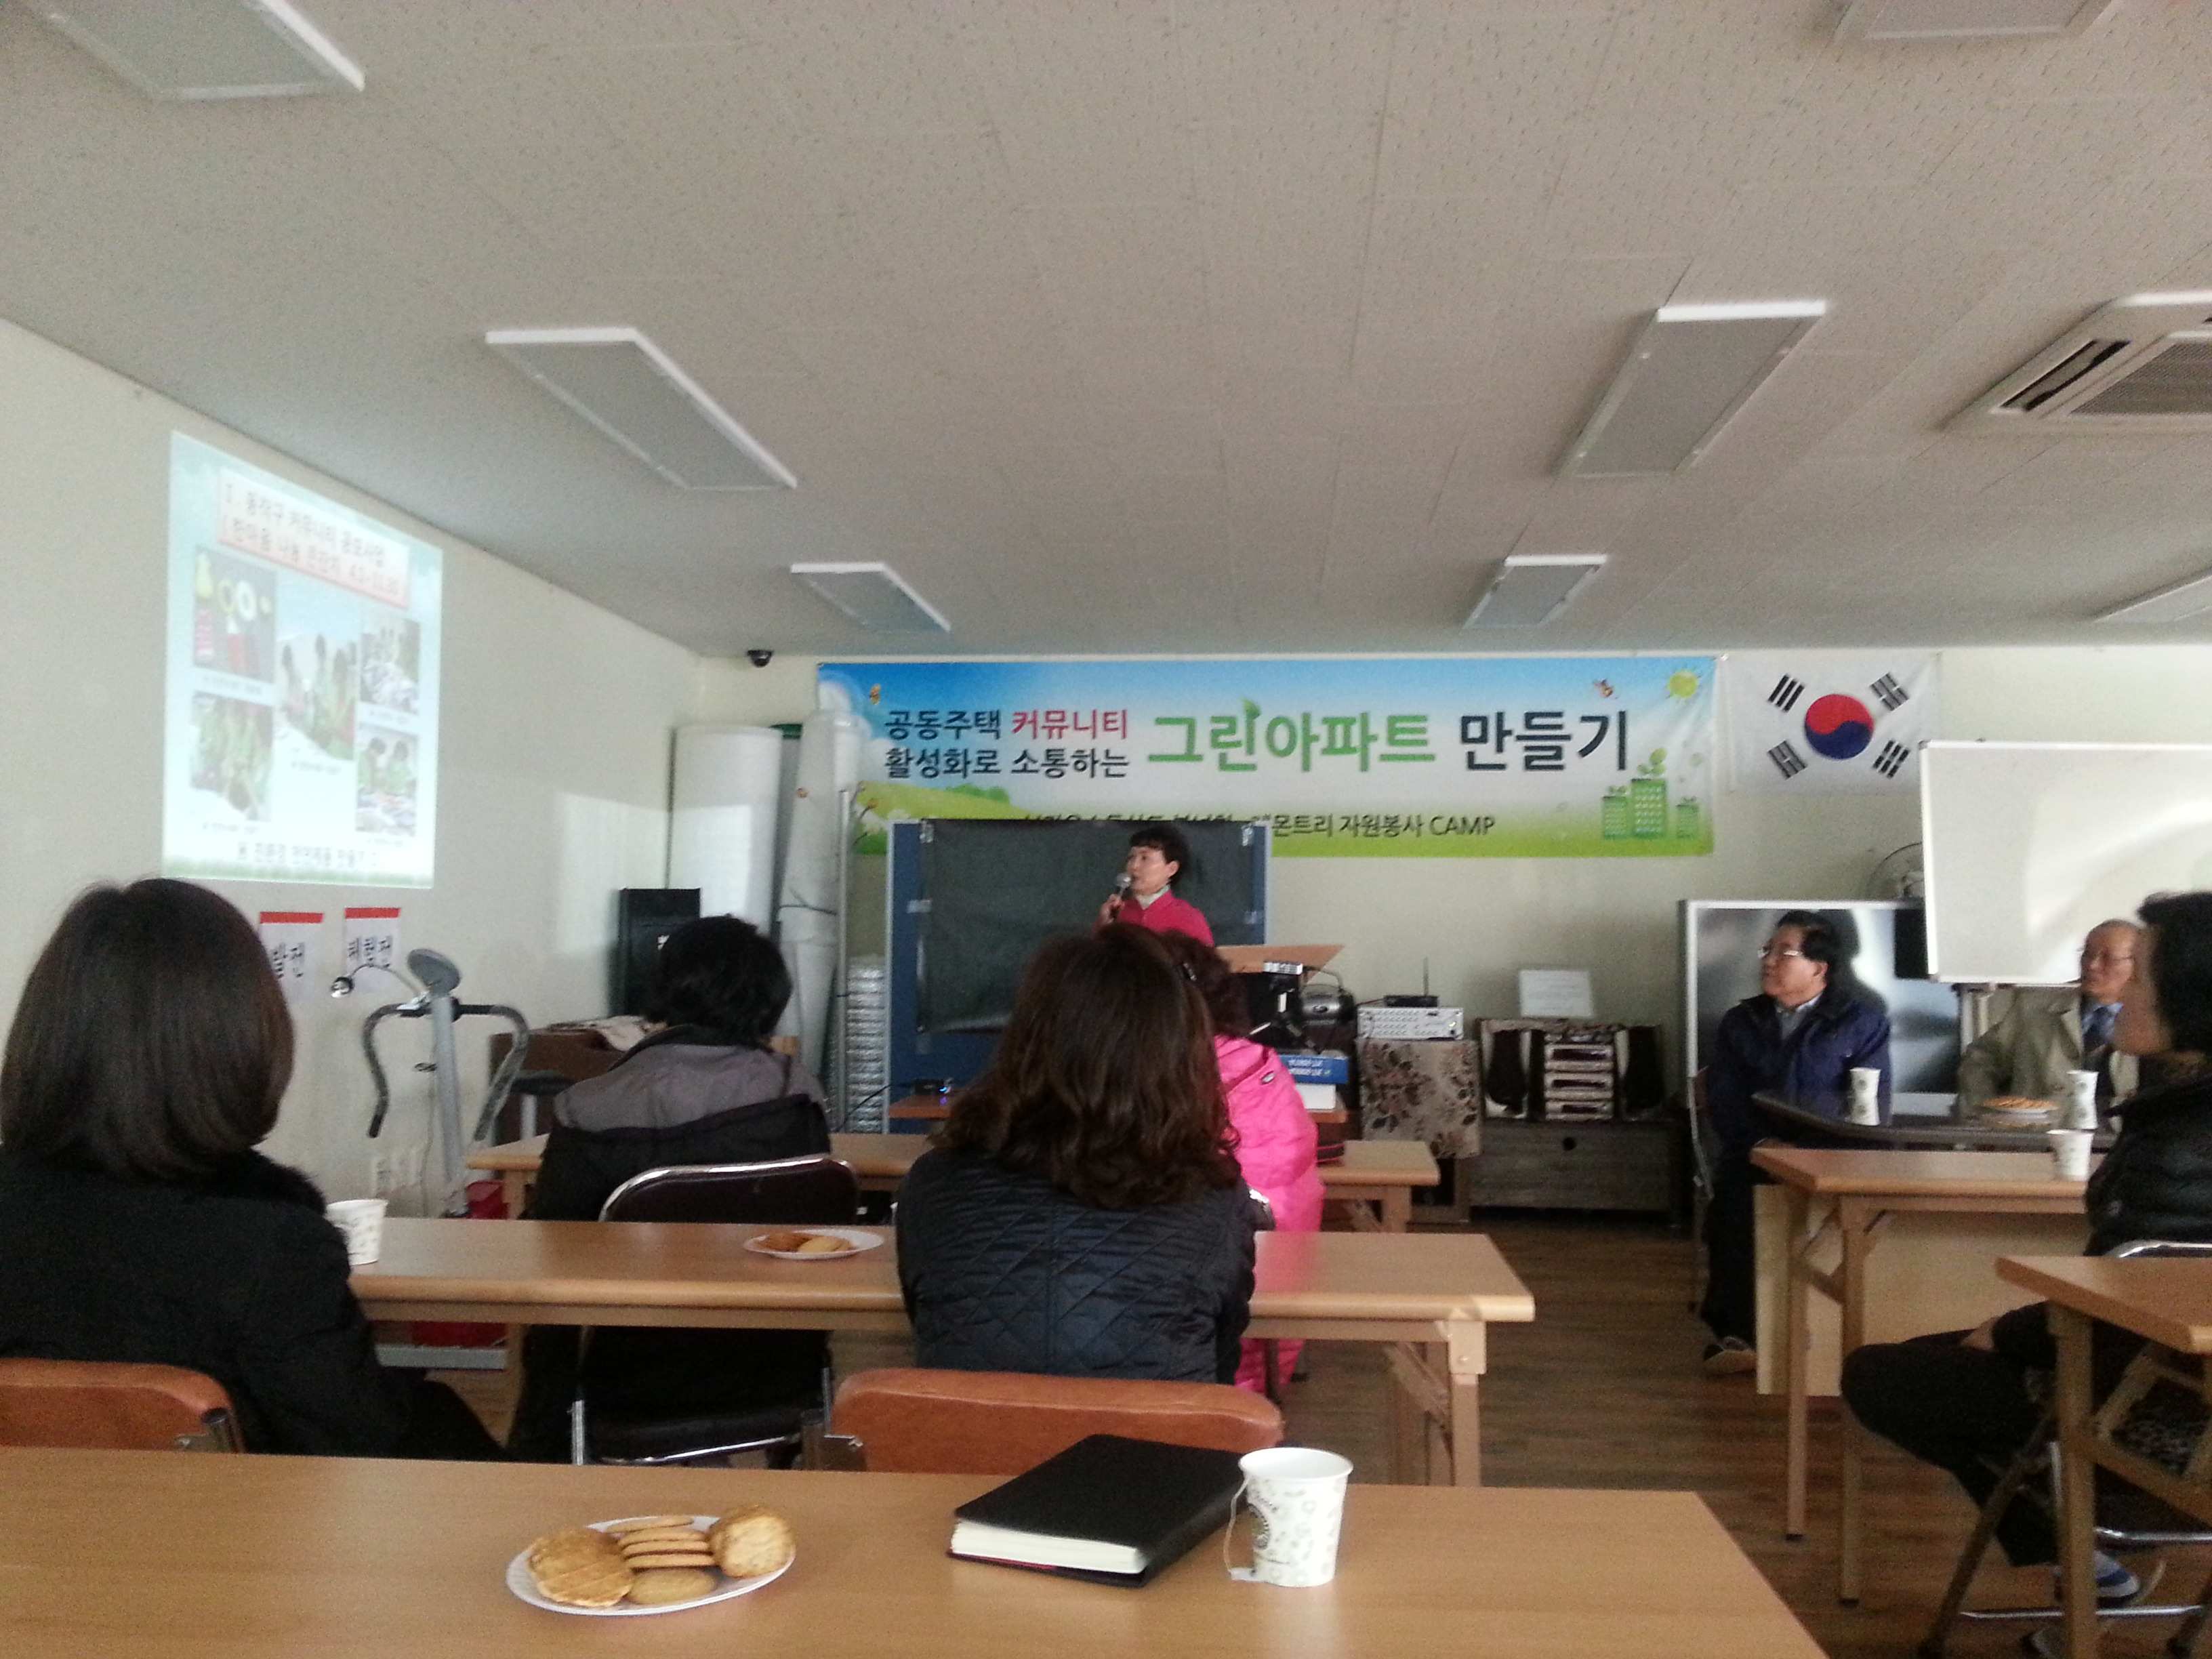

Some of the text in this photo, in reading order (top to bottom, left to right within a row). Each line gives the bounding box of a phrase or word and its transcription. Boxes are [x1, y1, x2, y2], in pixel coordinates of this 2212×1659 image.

[884, 709, 1128, 741] 공동주택 커뮤니티
[1148, 699, 1628, 773] 그린아파트 만들기
[884, 748, 1129, 779] 활성화로 소통하는
[1339, 814, 1424, 838] 자원봉사
[1429, 815, 1496, 836] CAMP
